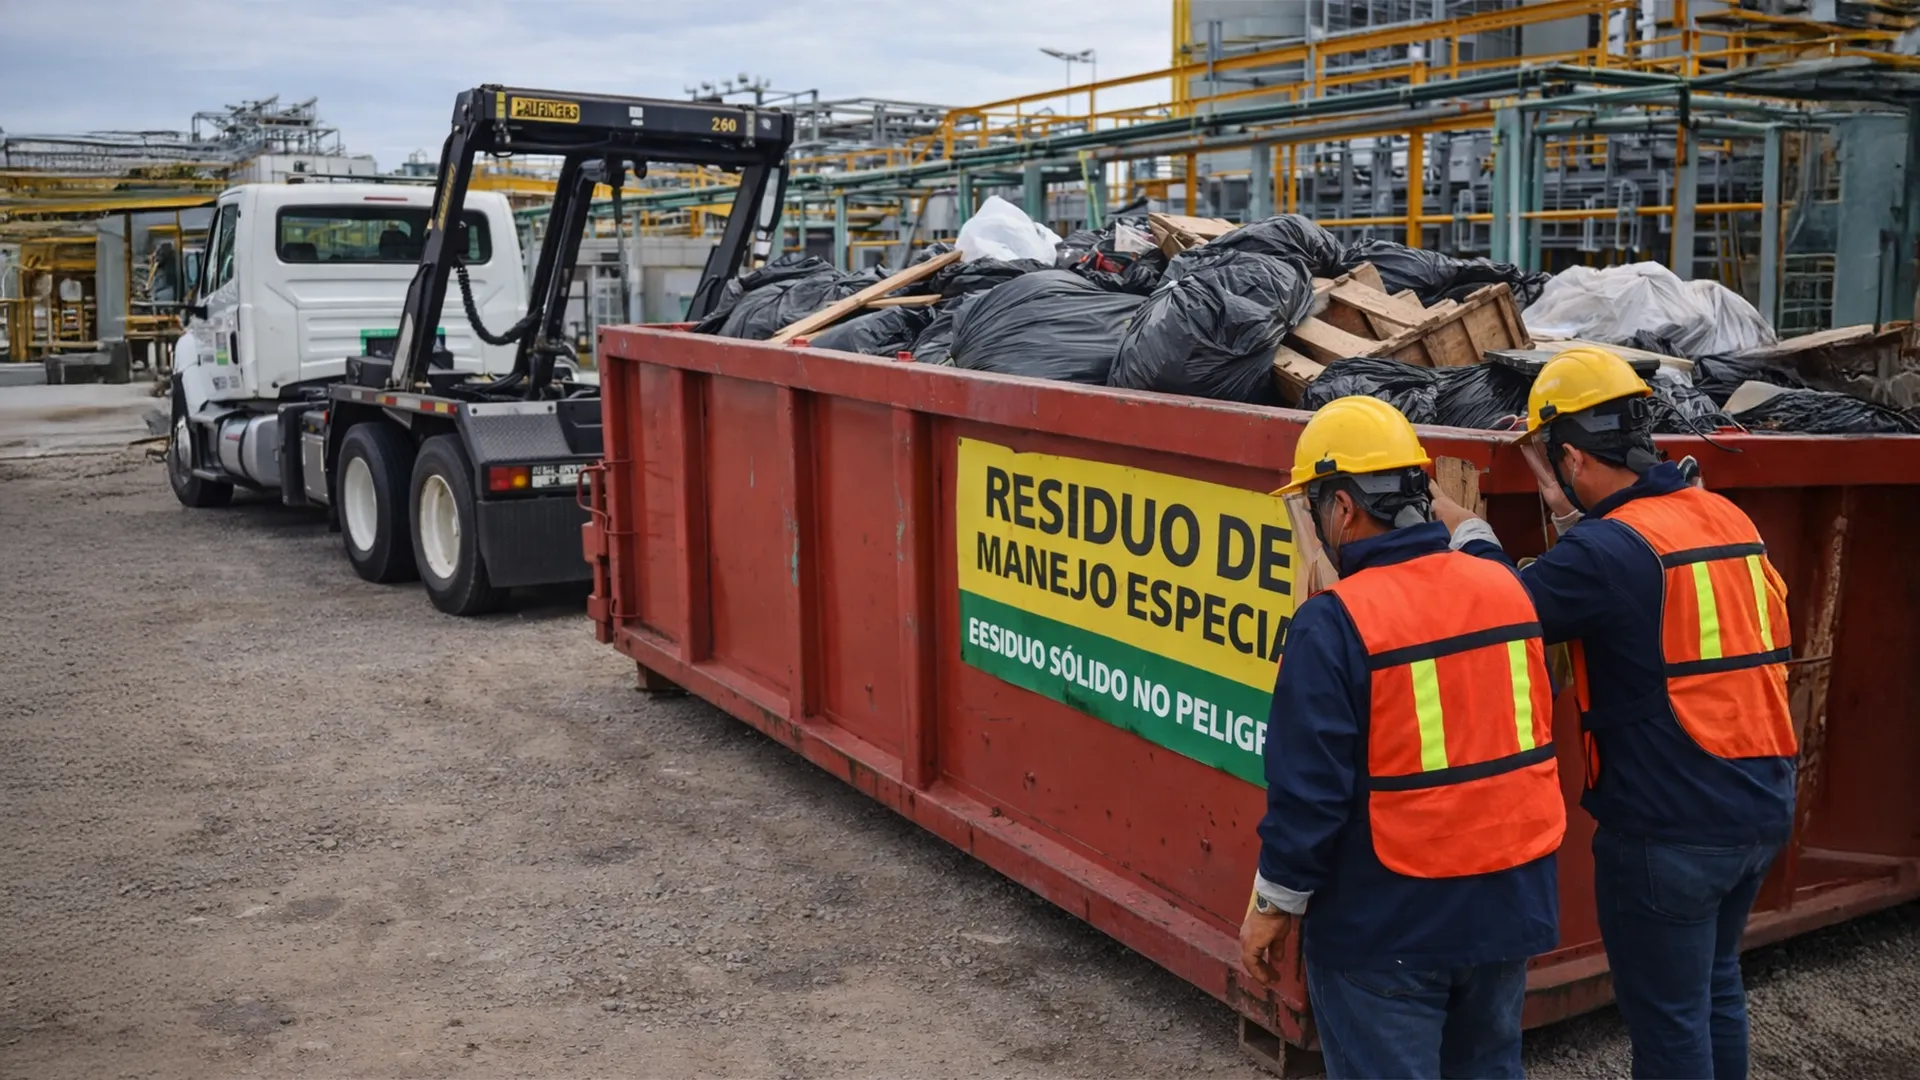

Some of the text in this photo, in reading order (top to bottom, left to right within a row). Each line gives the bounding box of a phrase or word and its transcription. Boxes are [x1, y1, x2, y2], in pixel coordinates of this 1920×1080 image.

[711, 116, 737, 132] 260
[977, 531, 1117, 609] MANEJO
[986, 466, 1293, 596] RESIDUO DE
[969, 617, 1046, 669] EESIDUO
[1050, 644, 1128, 702] SÓLIDO
[1133, 675, 1171, 718] NO
